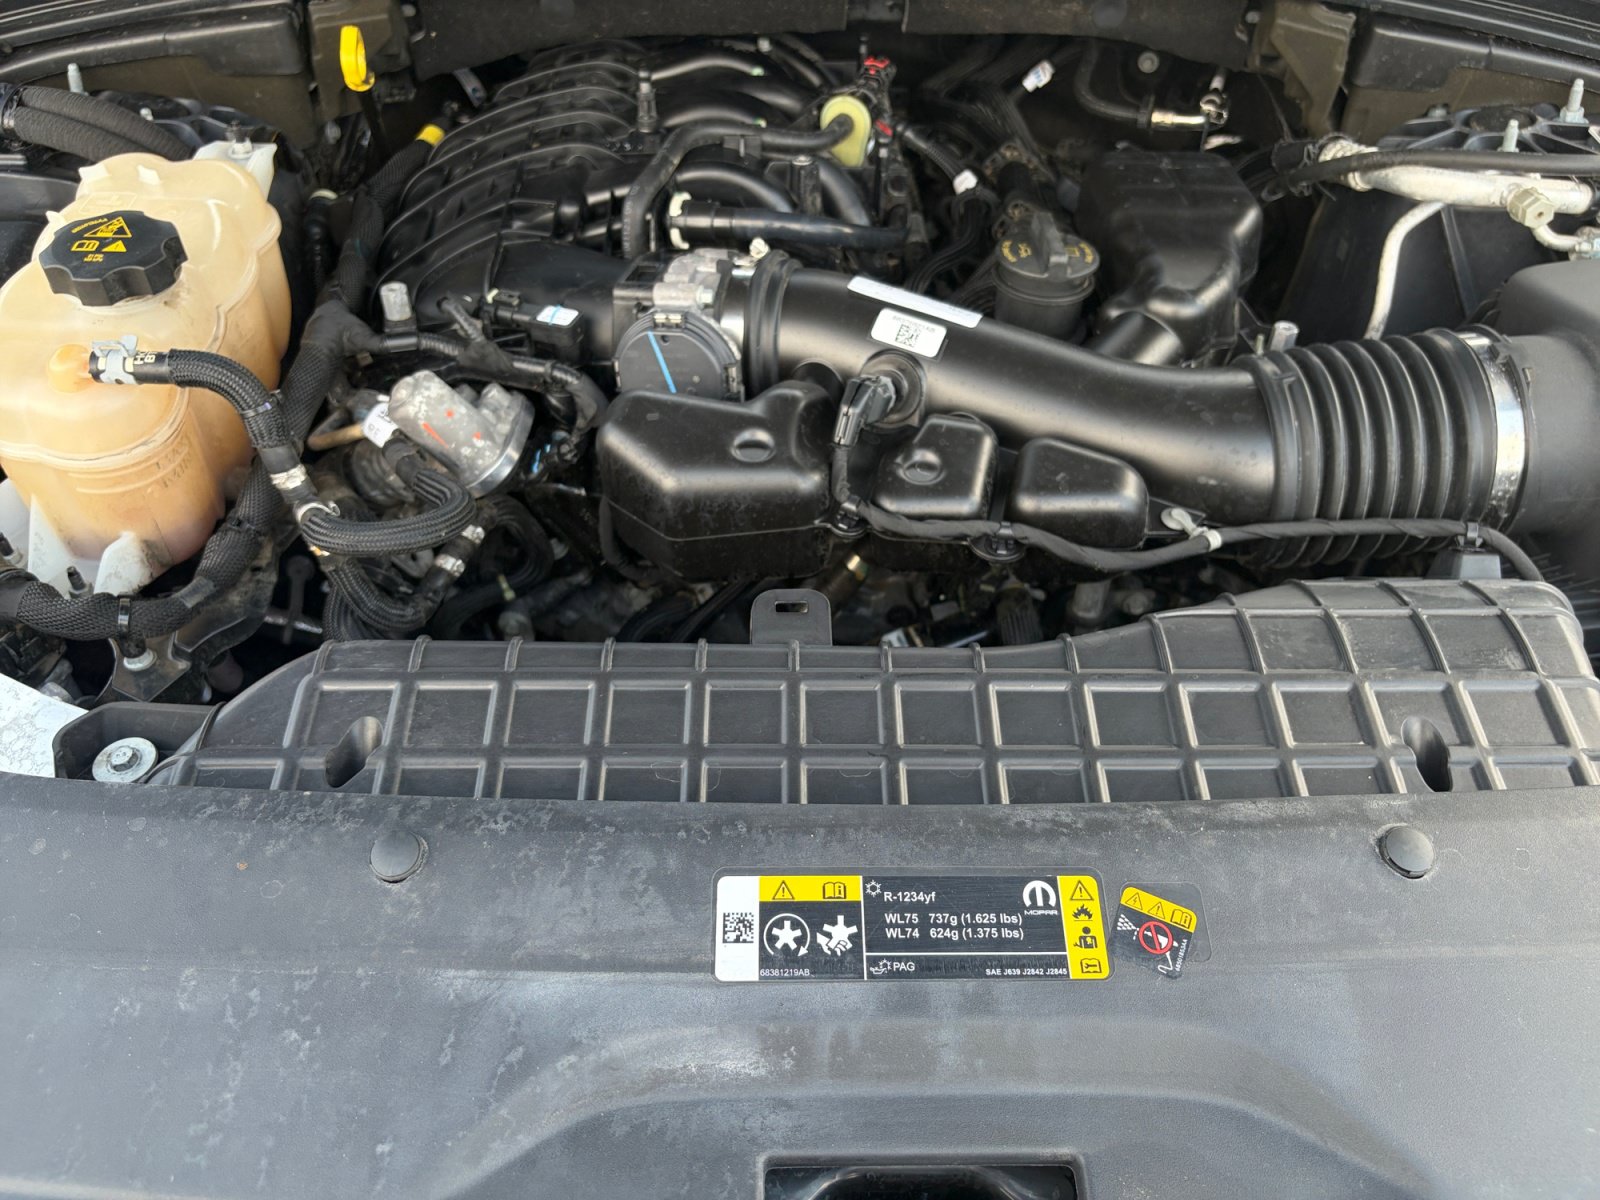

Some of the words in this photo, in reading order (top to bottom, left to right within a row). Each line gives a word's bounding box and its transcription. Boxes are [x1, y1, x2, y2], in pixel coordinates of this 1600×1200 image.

[883, 891, 936, 905] R-1234yf
[884, 913, 919, 924] WL75
[928, 912, 958, 926] 737g
[960, 912, 997, 926] (1.625
[999, 912, 1023, 926] lbs)
[885, 928, 920, 938] WL74
[929, 927, 959, 940] 624g
[961, 927, 999, 941] (1.375
[1001, 927, 1024, 941] lbs)
[759, 968, 810, 977] 68381219AB
[893, 961, 915, 972] PAG
[985, 968, 1002, 976] SAE
[1003, 968, 1021, 976] J639
[1022, 968, 1044, 976] J2842
[1045, 968, 1067, 976] J2845
